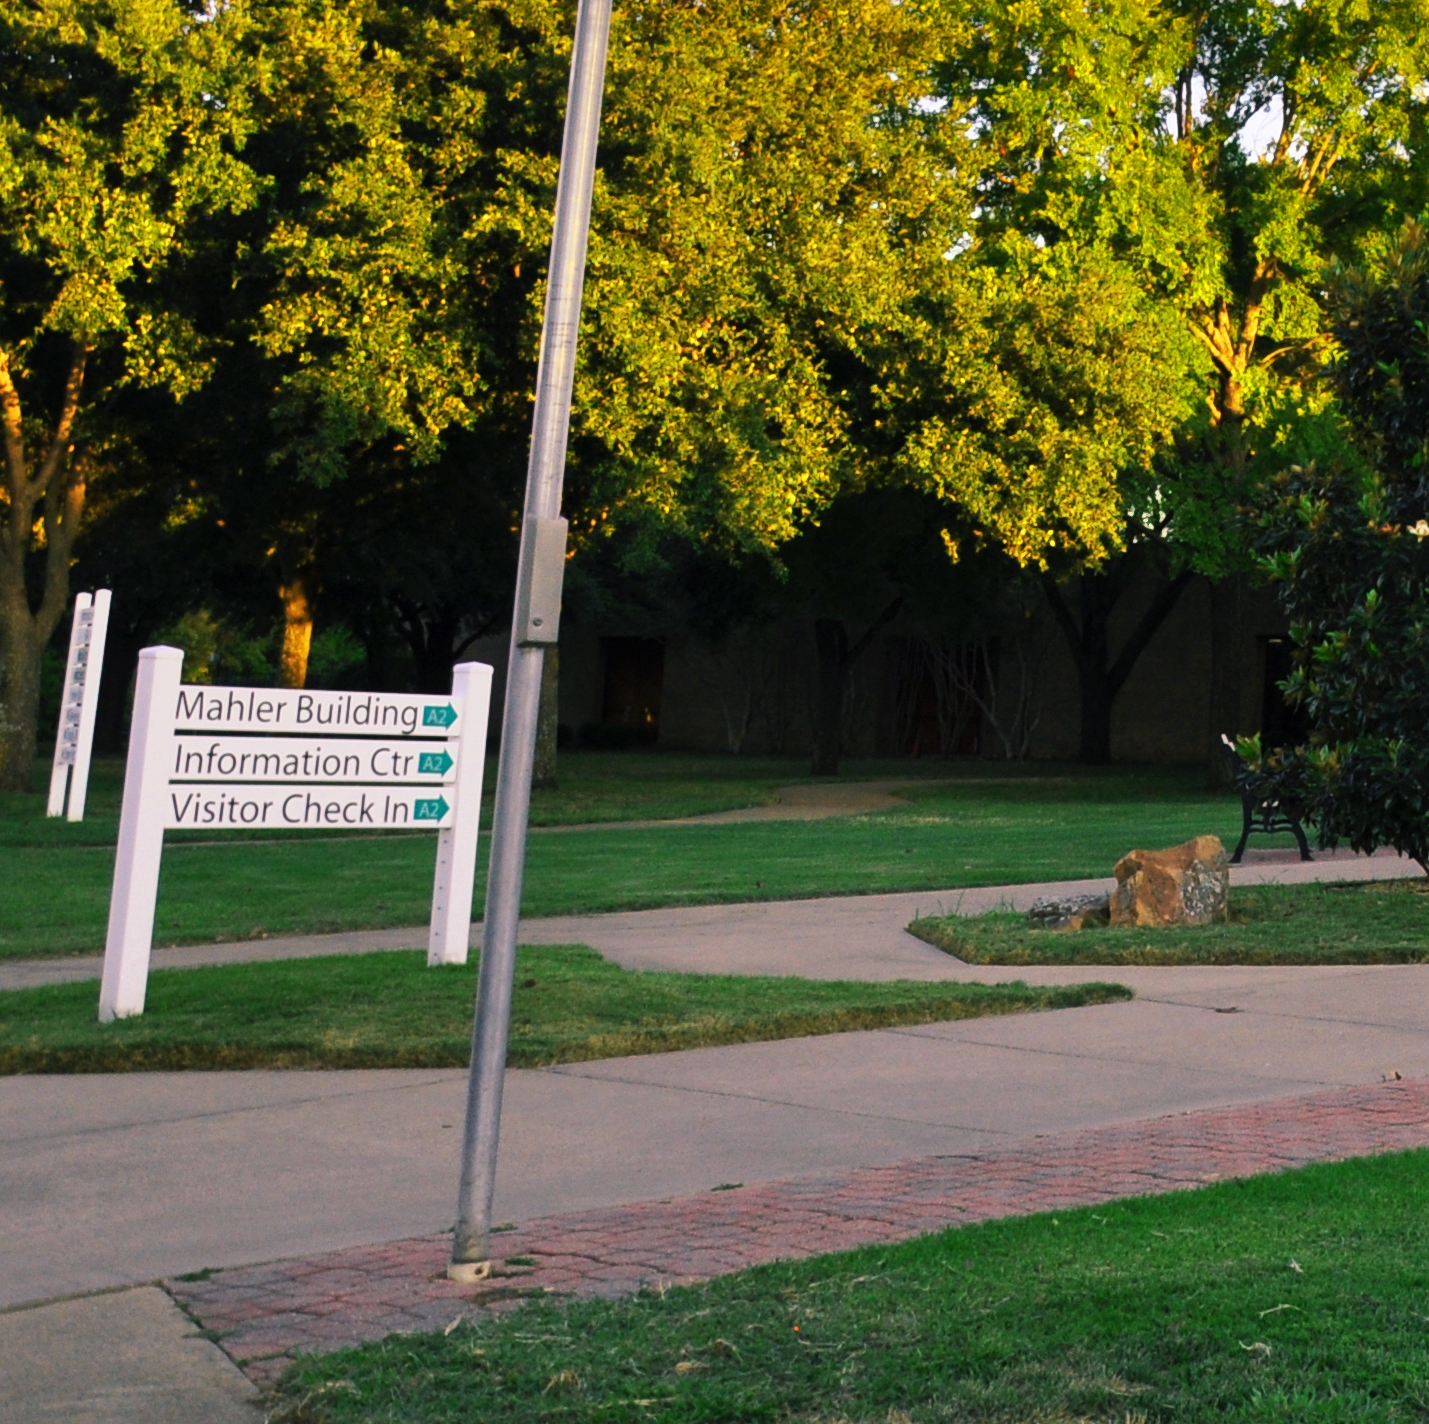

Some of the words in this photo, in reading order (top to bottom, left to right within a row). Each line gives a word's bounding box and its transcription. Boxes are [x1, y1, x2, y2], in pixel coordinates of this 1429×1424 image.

[174, 690, 287, 723] Mahler
[295, 694, 419, 735] Building
[426, 708, 448, 725] A2
[173, 742, 361, 777] Information
[370, 747, 415, 777] Ctr
[422, 756, 443, 772] A2
[171, 792, 274, 824] Visitor
[281, 793, 375, 824] Check
[383, 795, 409, 824] In
[418, 802, 440, 818] A2
